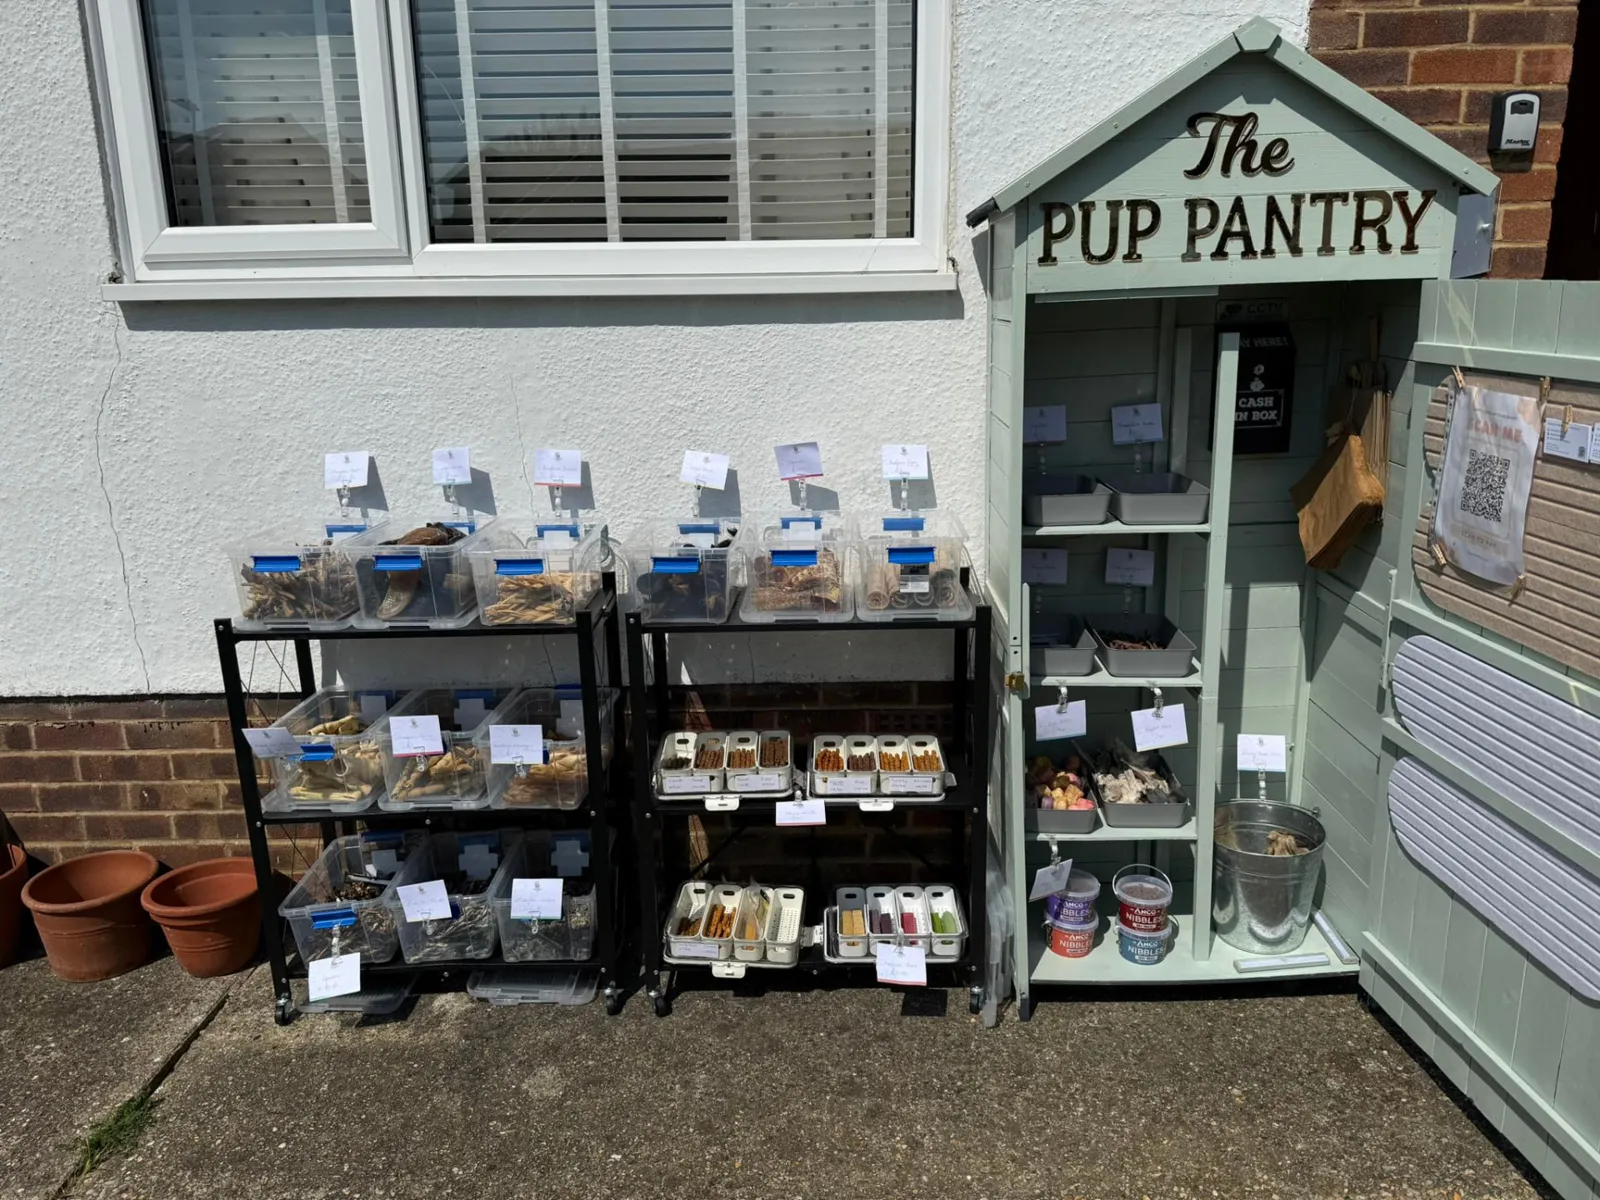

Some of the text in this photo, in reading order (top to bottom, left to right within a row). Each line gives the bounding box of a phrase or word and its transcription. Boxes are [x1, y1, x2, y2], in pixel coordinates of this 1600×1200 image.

[1183, 112, 1295, 179] The
[1037, 189, 1438, 267] PUP PANTRY
[1247, 302, 1283, 314] CCTV
[1238, 396, 1274, 408] CASH
[1252, 410, 1278, 421] BOX
[1502, 426, 1522, 443] ME
